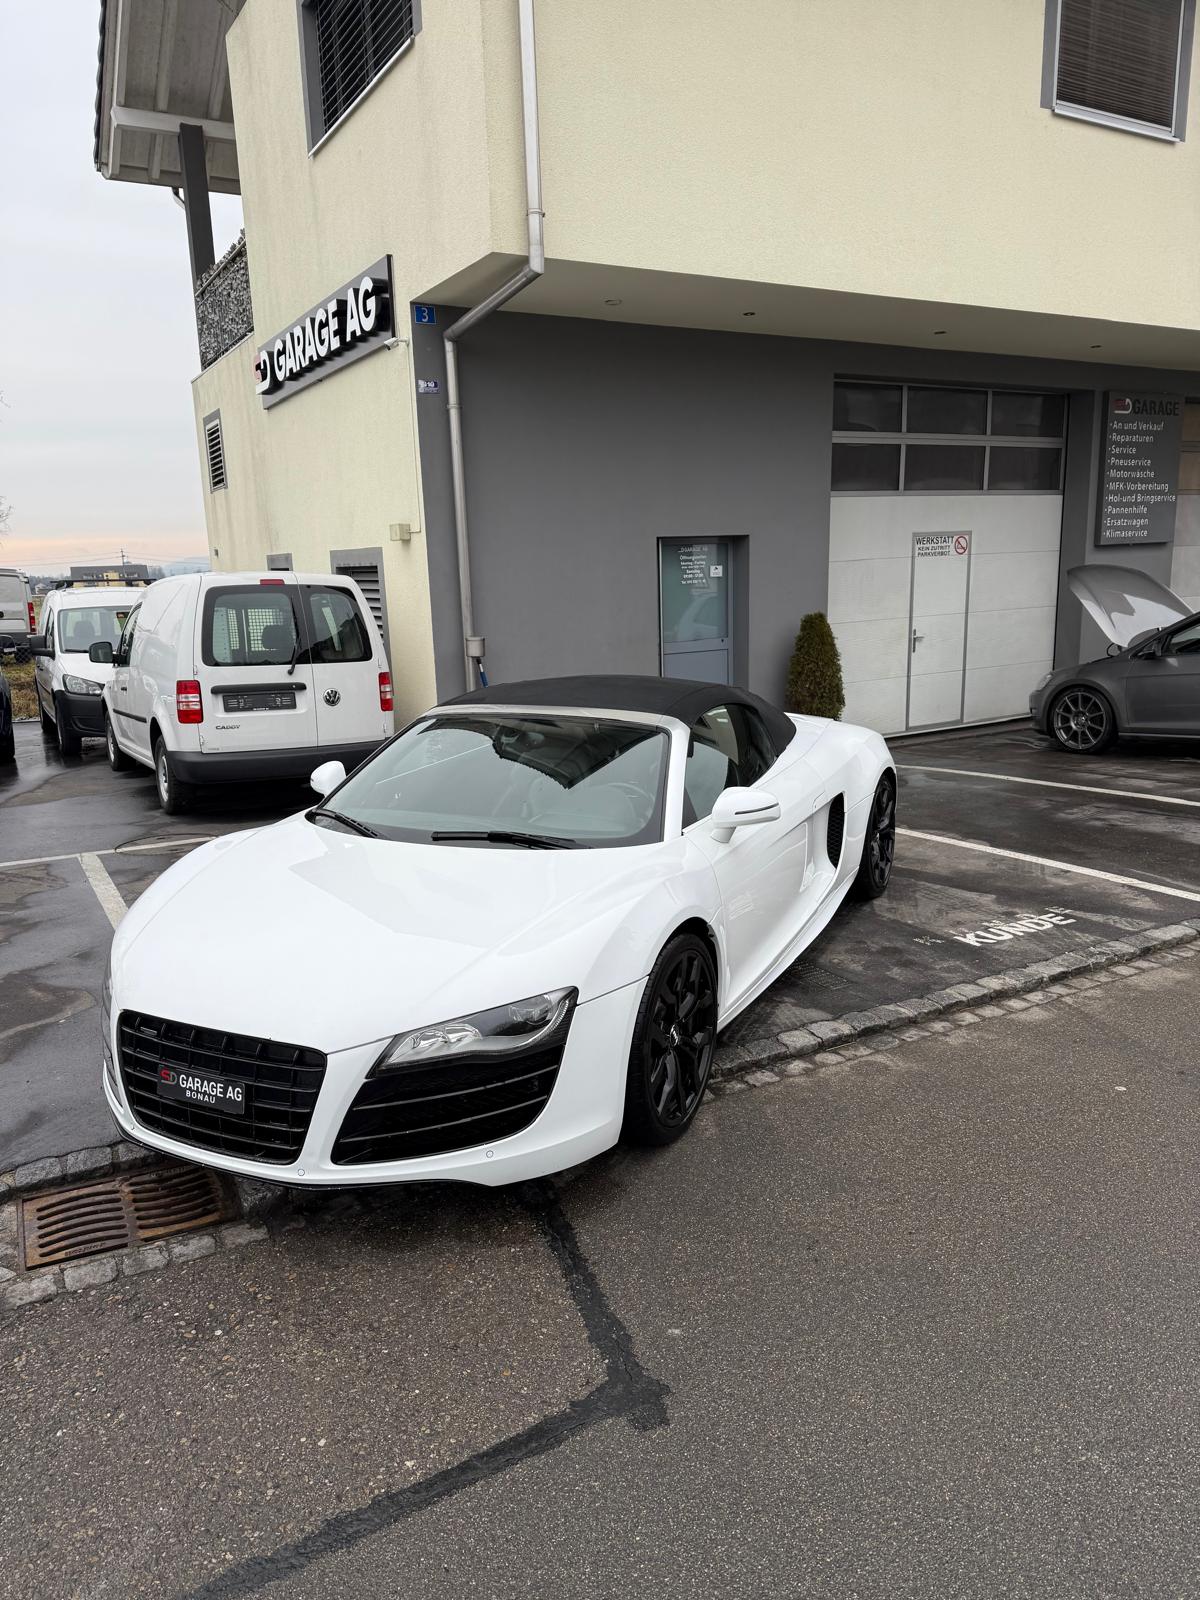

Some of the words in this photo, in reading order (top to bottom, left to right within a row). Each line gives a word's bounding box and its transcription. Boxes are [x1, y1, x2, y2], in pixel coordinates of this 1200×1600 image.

[421, 307, 429, 322] 3
[274, 299, 340, 382] GARAGE
[346, 276, 376, 342] AG
[1133, 400, 1179, 416] GARAGE
[1113, 421, 1122, 430] An
[1124, 421, 1136, 430] und
[1139, 421, 1164, 431] Verkauf
[1112, 433, 1154, 443] Reparaturen
[1111, 445, 1137, 454] Service
[1110, 457, 1151, 466] Pneuservice
[1109, 482, 1169, 492] MFK-Vorbereitung
[1137, 493, 1176, 503] Bringservice
[1107, 505, 1148, 514] Pannenhilfe
[1106, 517, 1149, 526] Ersatzwagen
[1105, 529, 1148, 538] Klimaservice
[916, 536, 954, 545] WERKSTATT
[954, 913, 1077, 947] KUNDE
[180, 1074, 224, 1098] GARAGE
[226, 1085, 242, 1101] AG
[186, 1089, 215, 1103] BONAU
